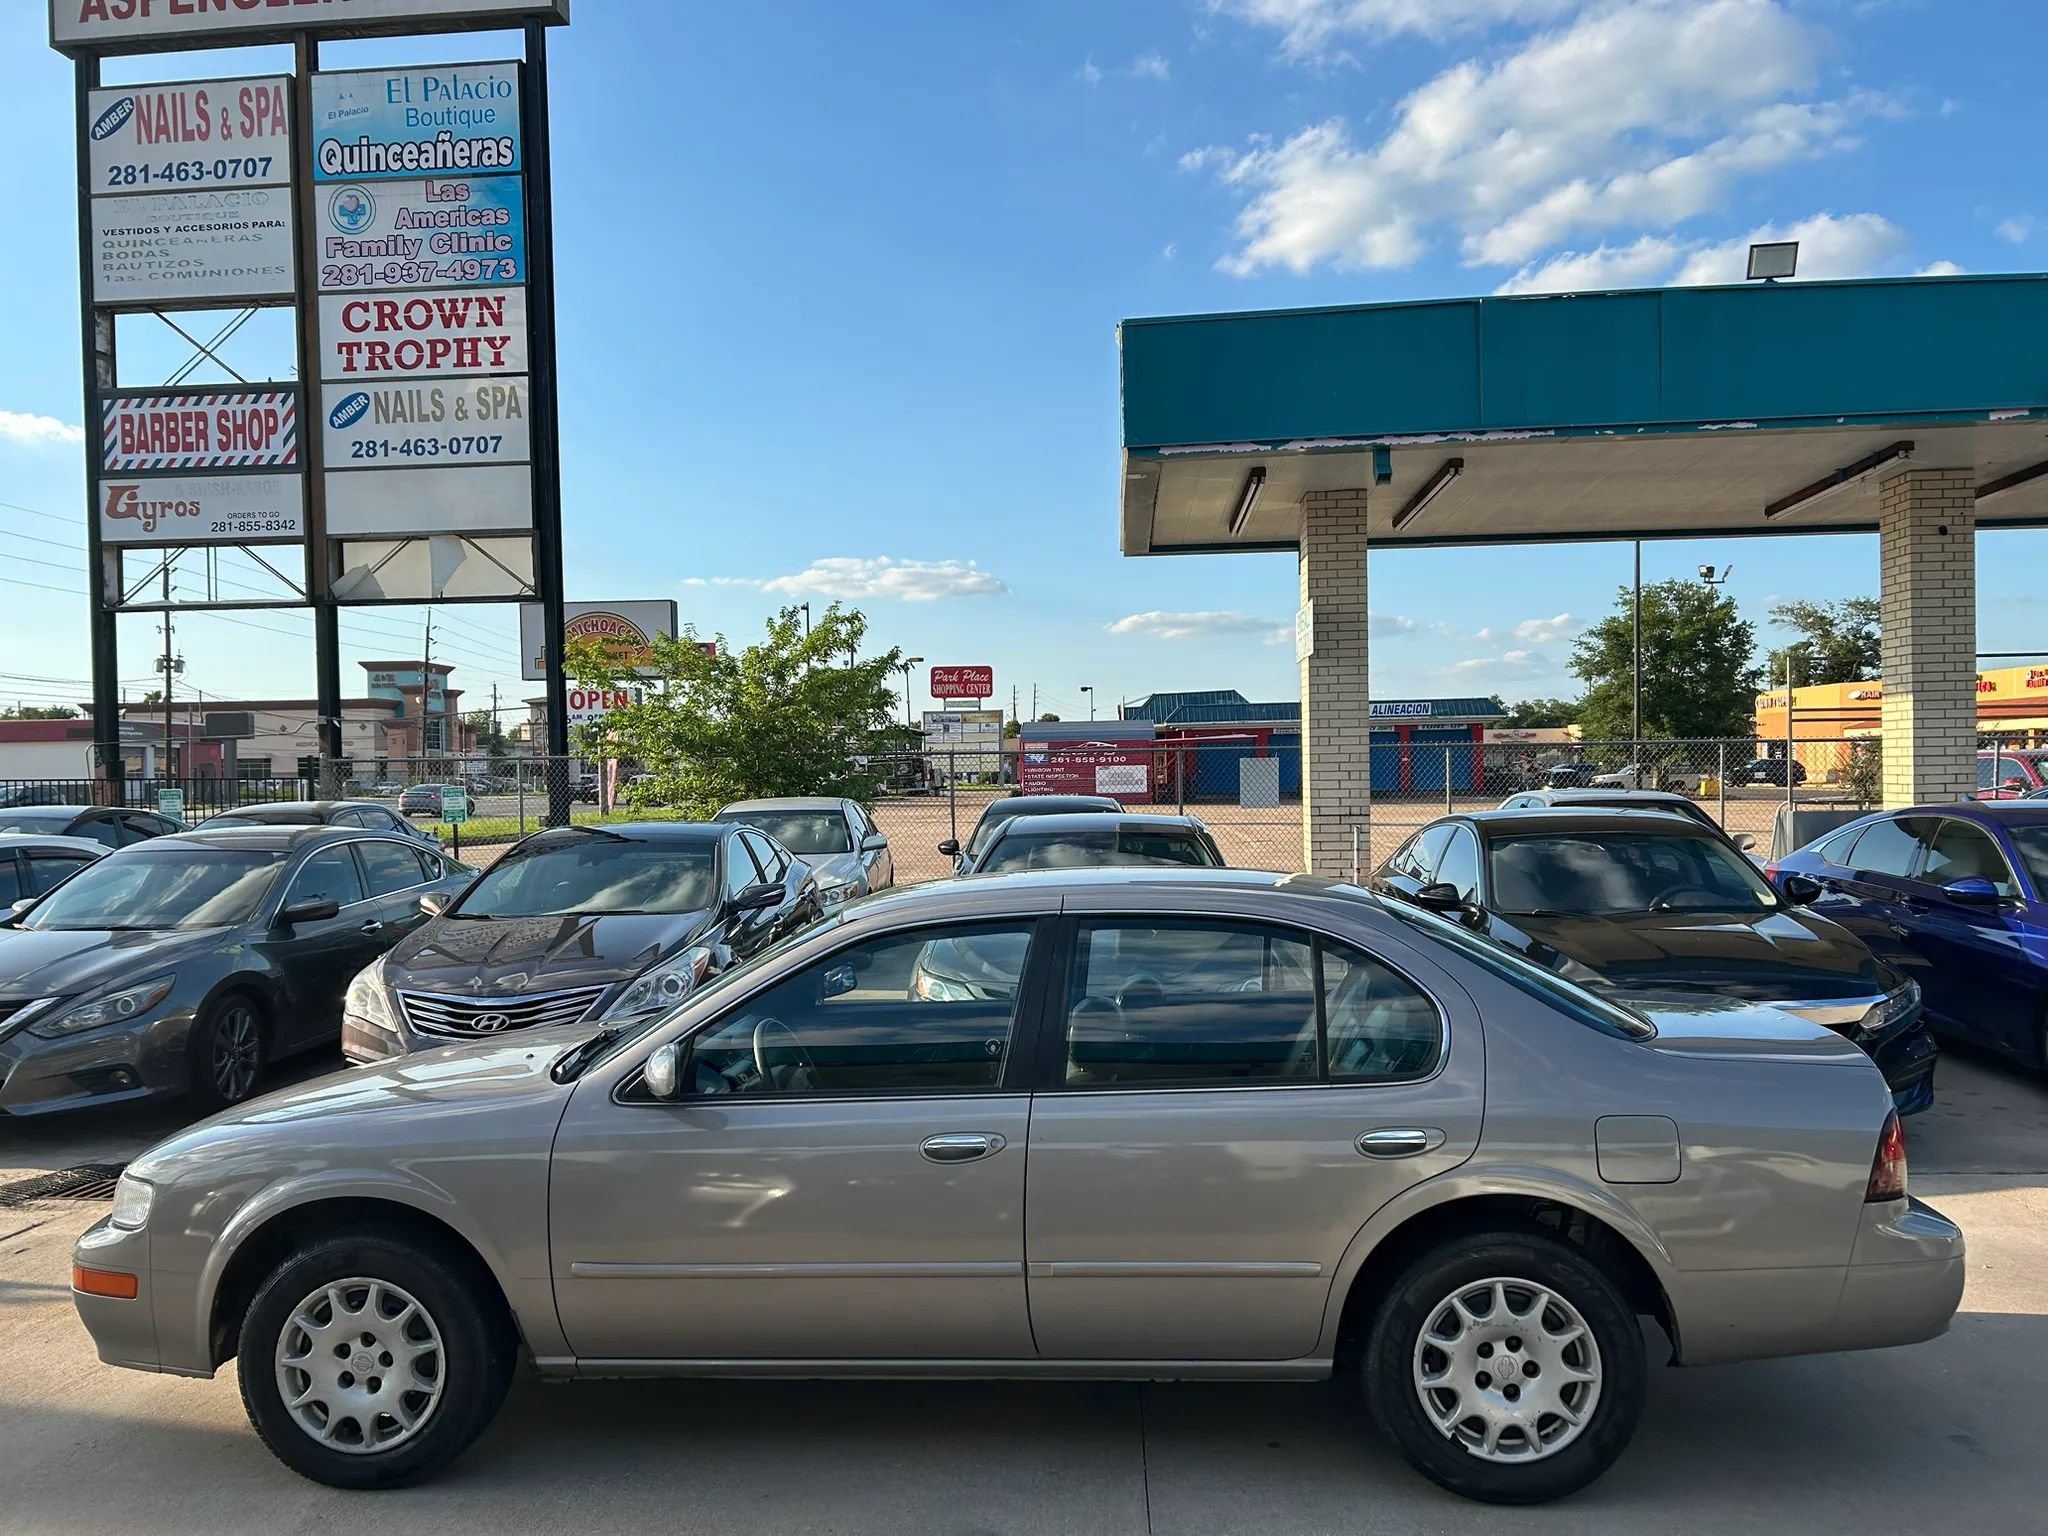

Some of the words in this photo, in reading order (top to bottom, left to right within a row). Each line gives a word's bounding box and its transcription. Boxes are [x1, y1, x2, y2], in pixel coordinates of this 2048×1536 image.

[387, 76, 412, 103] El
[94, 99, 134, 139] AMBER
[135, 90, 211, 145] NAILS
[221, 106, 232, 140] &
[238, 85, 288, 139] SPA
[328, 112, 337, 120] El
[338, 105, 369, 118] Palacio
[406, 106, 496, 128] Boutique
[318, 130, 514, 175] Quinceañeras
[107, 156, 273, 186] 281-463-0707
[425, 181, 471, 203] Las
[102, 226, 160, 236] VESTIDOS
[175, 222, 249, 233] ACCESORIOS
[252, 220, 286, 229] PARA:
[394, 206, 510, 229] Americas
[102, 249, 170, 260] BODAS
[325, 234, 423, 260] Family
[430, 231, 513, 254] Clinic
[103, 259, 204, 271] BAUTIZOS
[104, 273, 142, 282] 1as.
[148, 265, 286, 281] COMUNIONES
[322, 258, 517, 287] 281-937-4973
[341, 296, 506, 333] CROWN
[337, 335, 511, 372] TROPHY
[332, 393, 369, 428] AMBER
[373, 388, 446, 425] NAILS
[454, 396, 469, 422] &
[476, 385, 522, 421] SPA
[120, 410, 210, 455] BARBER
[216, 408, 279, 452] SHOP
[351, 435, 503, 459] 281-463-0707
[105, 484, 200, 533] Gyros
[227, 511, 256, 520] ORDERS
[211, 519, 296, 533] 281-855-8342
[934, 670, 960, 682] Park
[962, 669, 990, 682] Place
[569, 689, 628, 711] OPEN
[932, 683, 965, 695] SHOPPING
[966, 683, 991, 694] CENTER
[1371, 703, 1430, 715] ALINEACION
